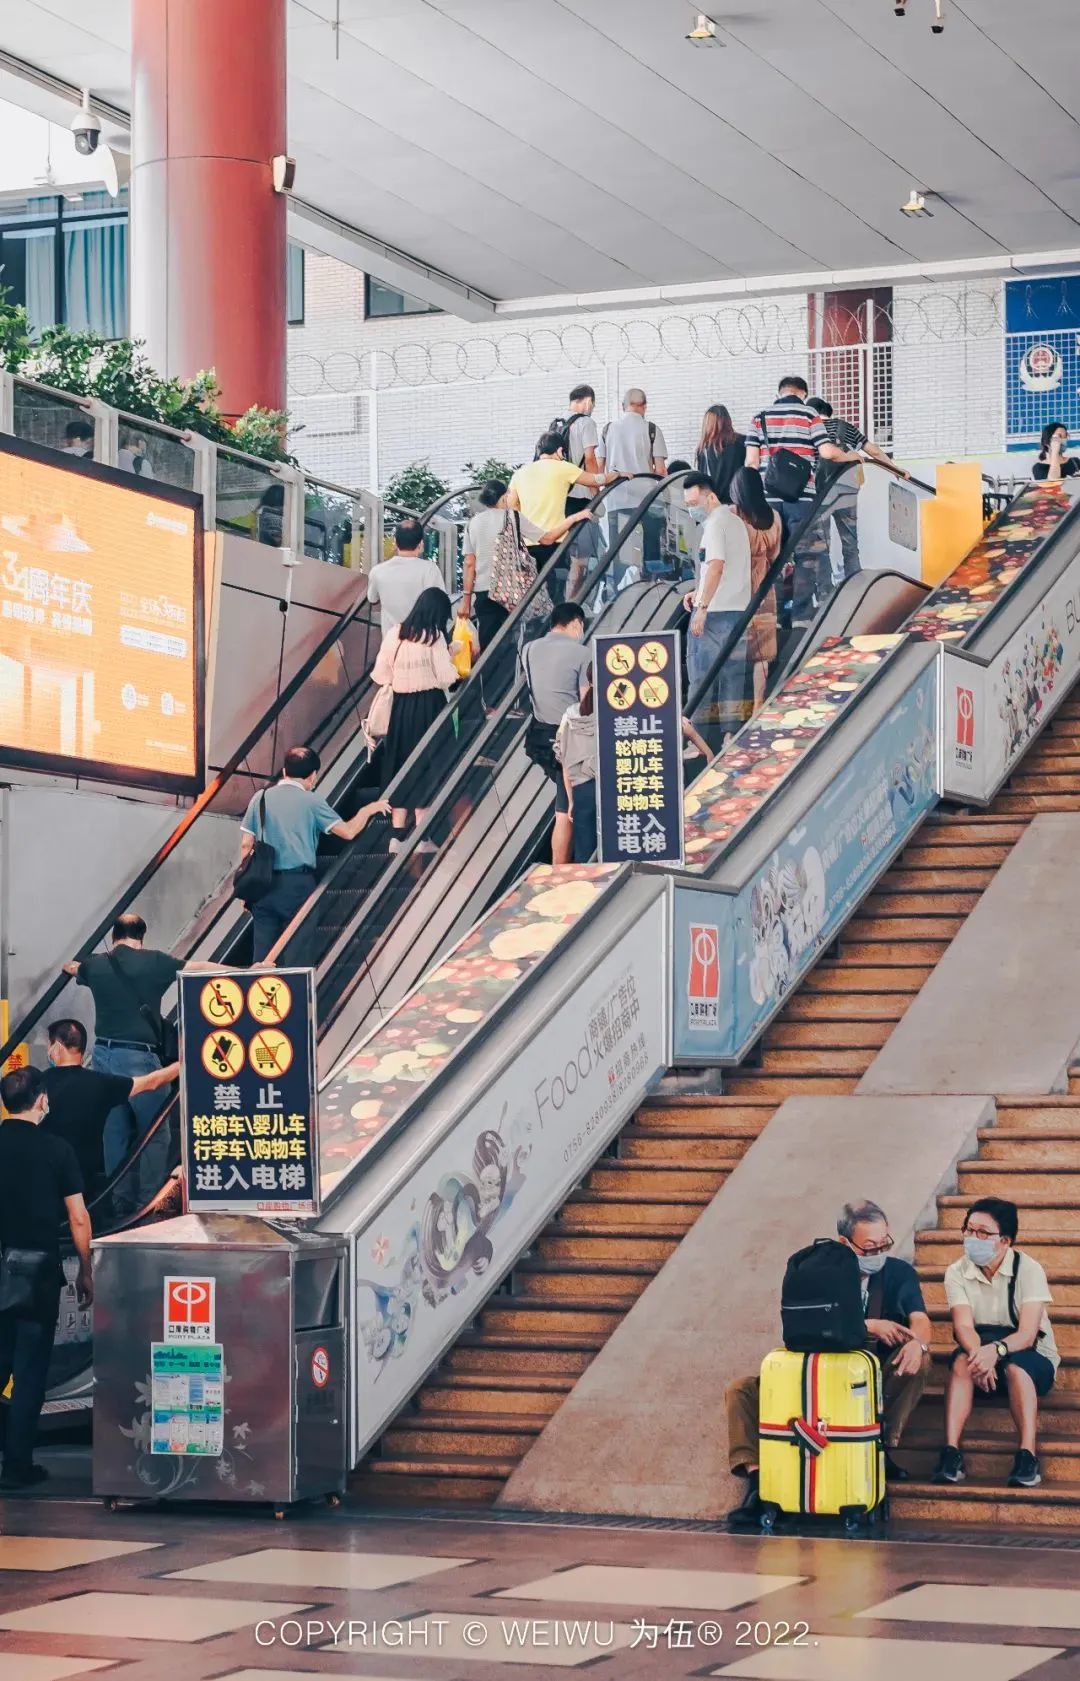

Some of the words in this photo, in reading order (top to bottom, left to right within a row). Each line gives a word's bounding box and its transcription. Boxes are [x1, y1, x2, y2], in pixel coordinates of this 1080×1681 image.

[614, 714, 664, 737] 禁止
[615, 738, 663, 757] 轮椅车
[616, 756, 664, 775] 婴儿车
[616, 775, 664, 793] 行李车
[617, 793, 664, 811] 购物车
[617, 813, 666, 834] 进入
[618, 832, 667, 853] 电梯
[534, 1030, 592, 1130] Food
[213, 1083, 284, 1110] 禁止
[192, 1113, 306, 1137] 轮椅车\婴儿车
[193, 1137, 307, 1161] 行李车\购物车
[195, 1164, 306, 1191] 进入电梯
